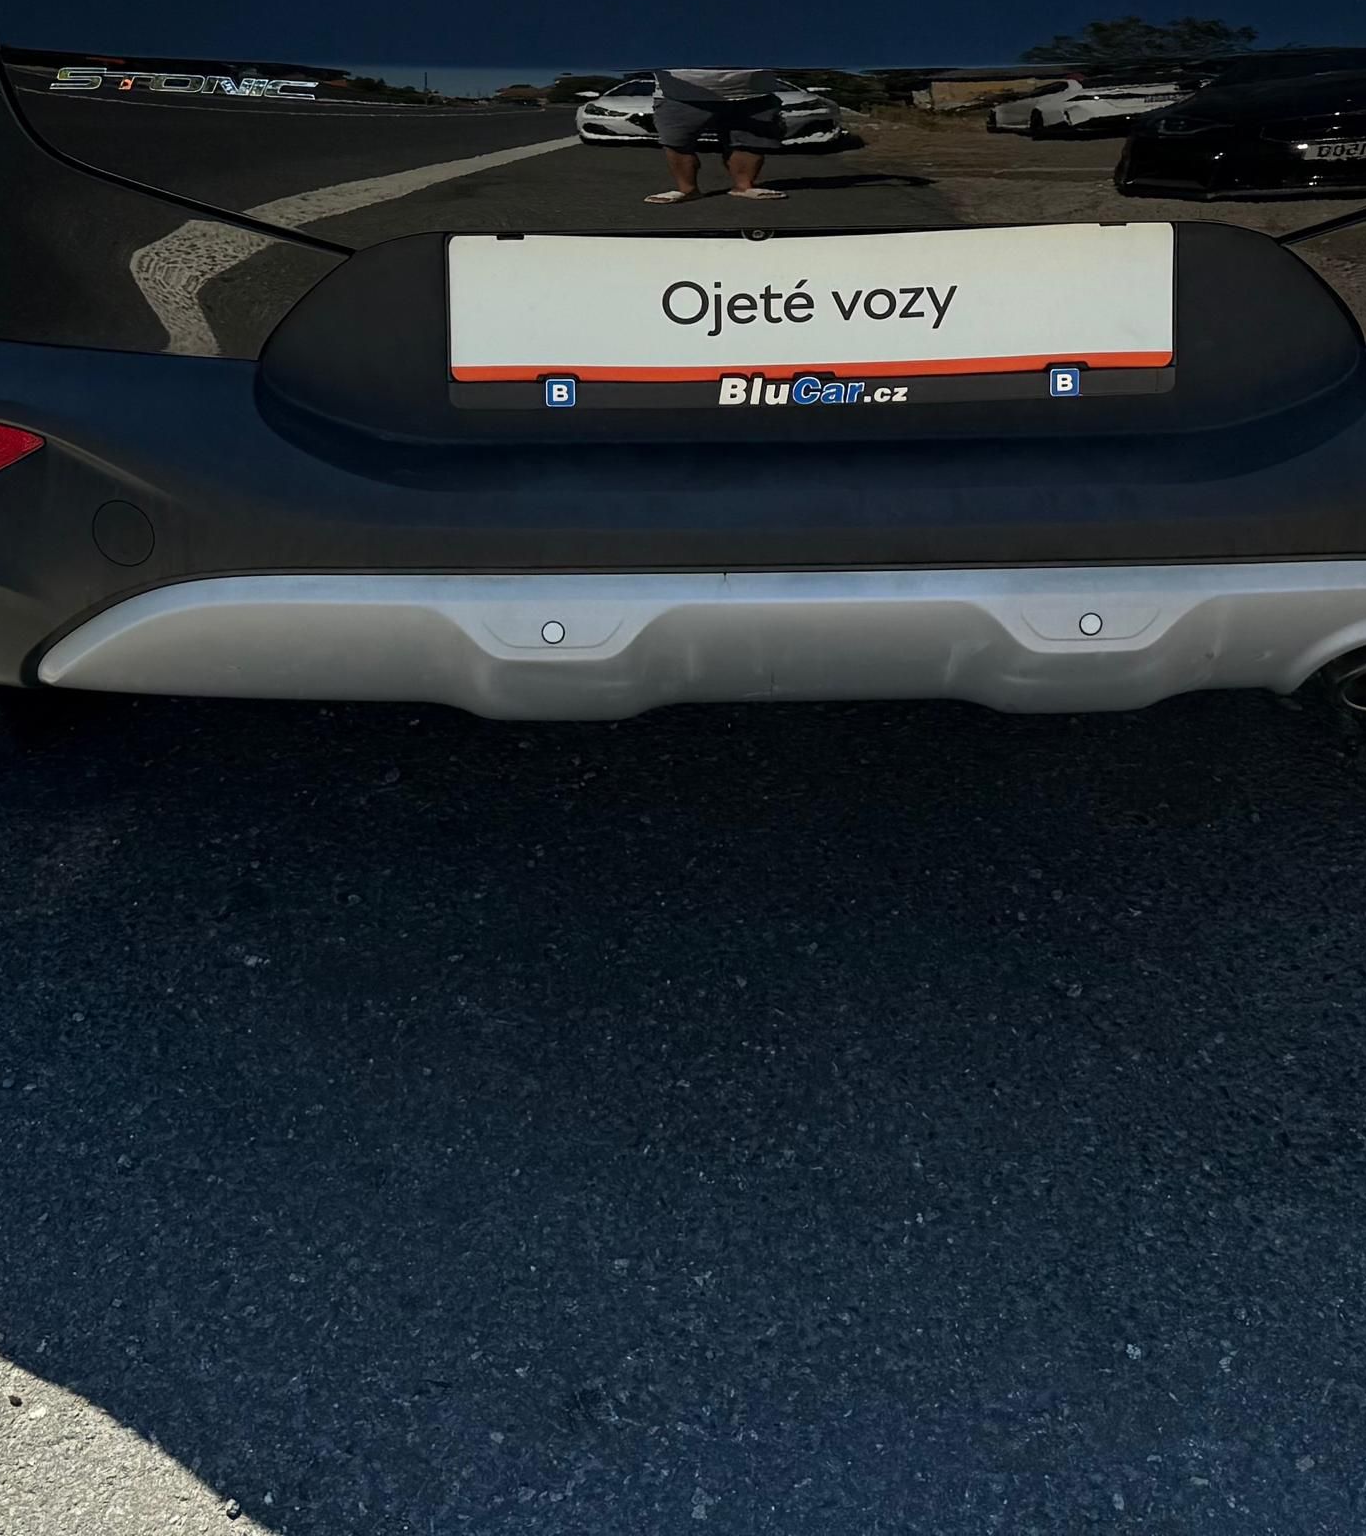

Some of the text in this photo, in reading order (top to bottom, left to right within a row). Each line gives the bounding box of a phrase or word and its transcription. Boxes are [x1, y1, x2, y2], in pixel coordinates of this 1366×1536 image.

[49, 66, 319, 101] STONIC
[661, 279, 958, 337] Ojeté vozy
[551, 383, 569, 402] B
[718, 376, 908, 406] BluCar.cz
[1056, 373, 1074, 392] B
